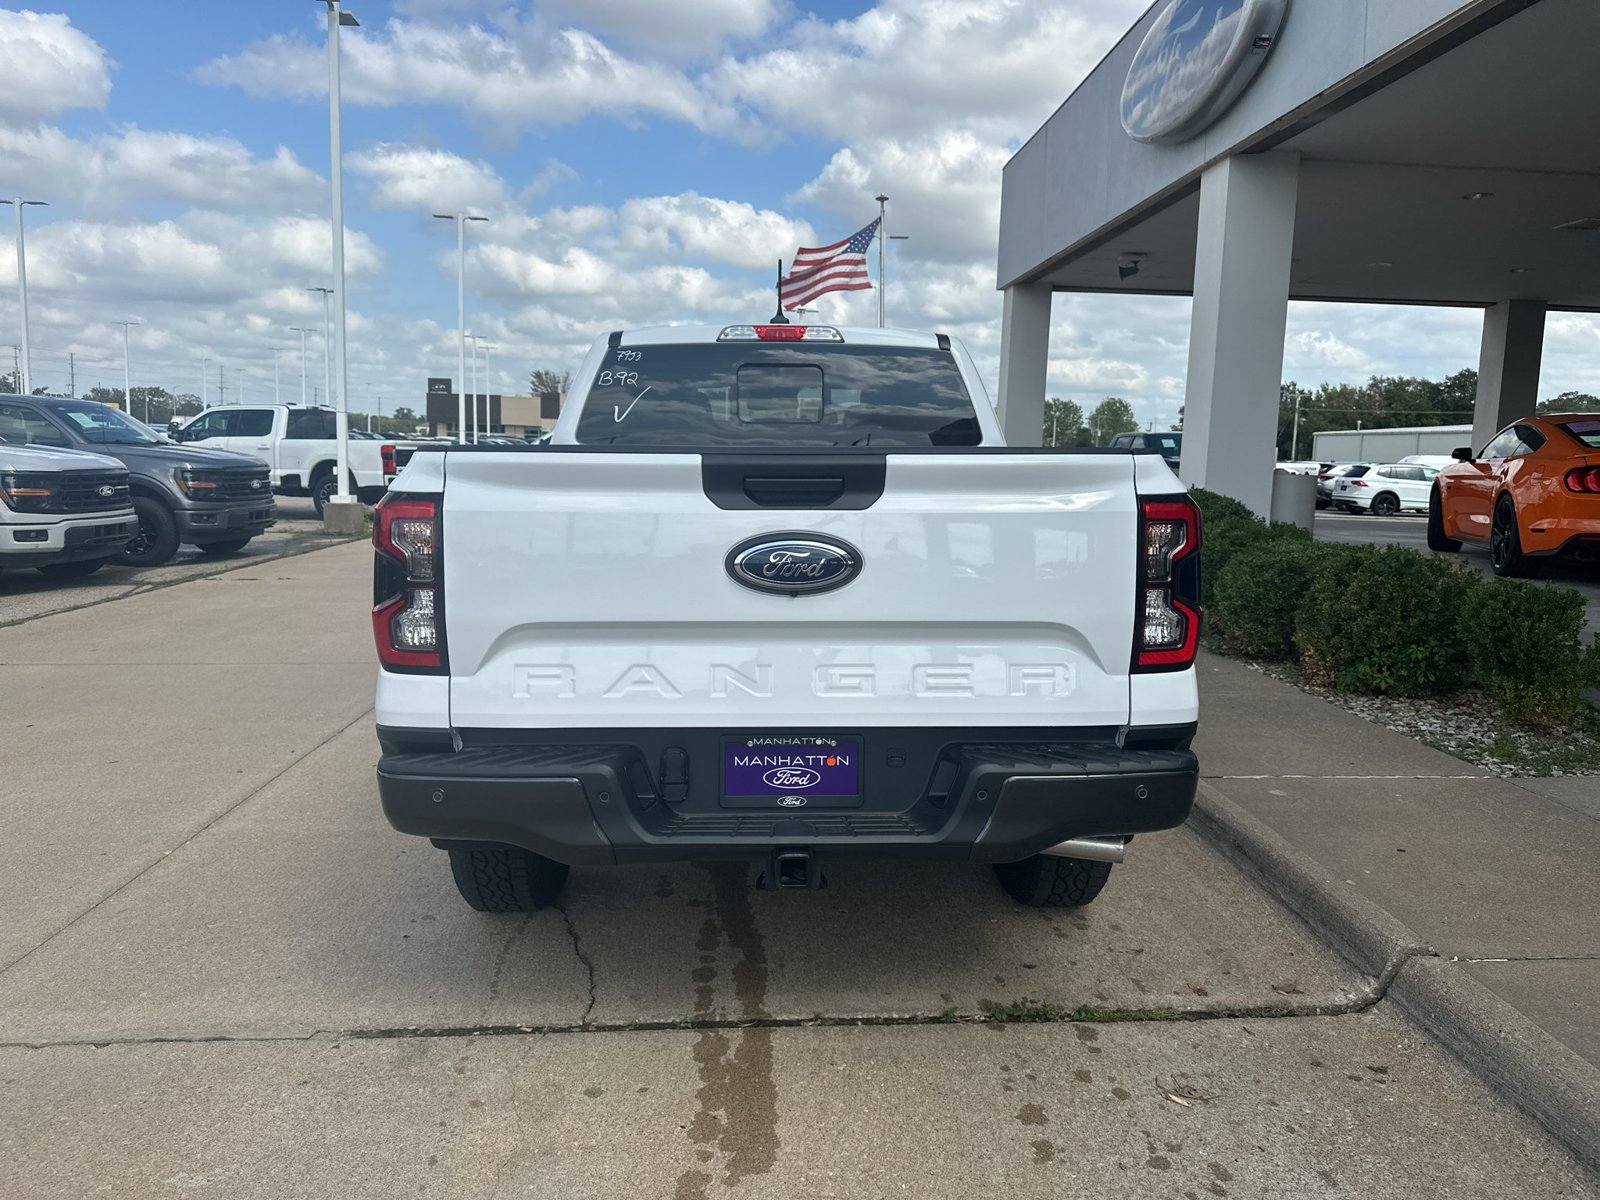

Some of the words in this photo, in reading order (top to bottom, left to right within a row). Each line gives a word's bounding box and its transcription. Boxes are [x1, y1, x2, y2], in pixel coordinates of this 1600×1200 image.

[762, 550, 825, 577] Ford
[512, 662, 1077, 698] RANGER
[772, 769, 811, 785] Ford
[782, 797, 801, 805] Ford
